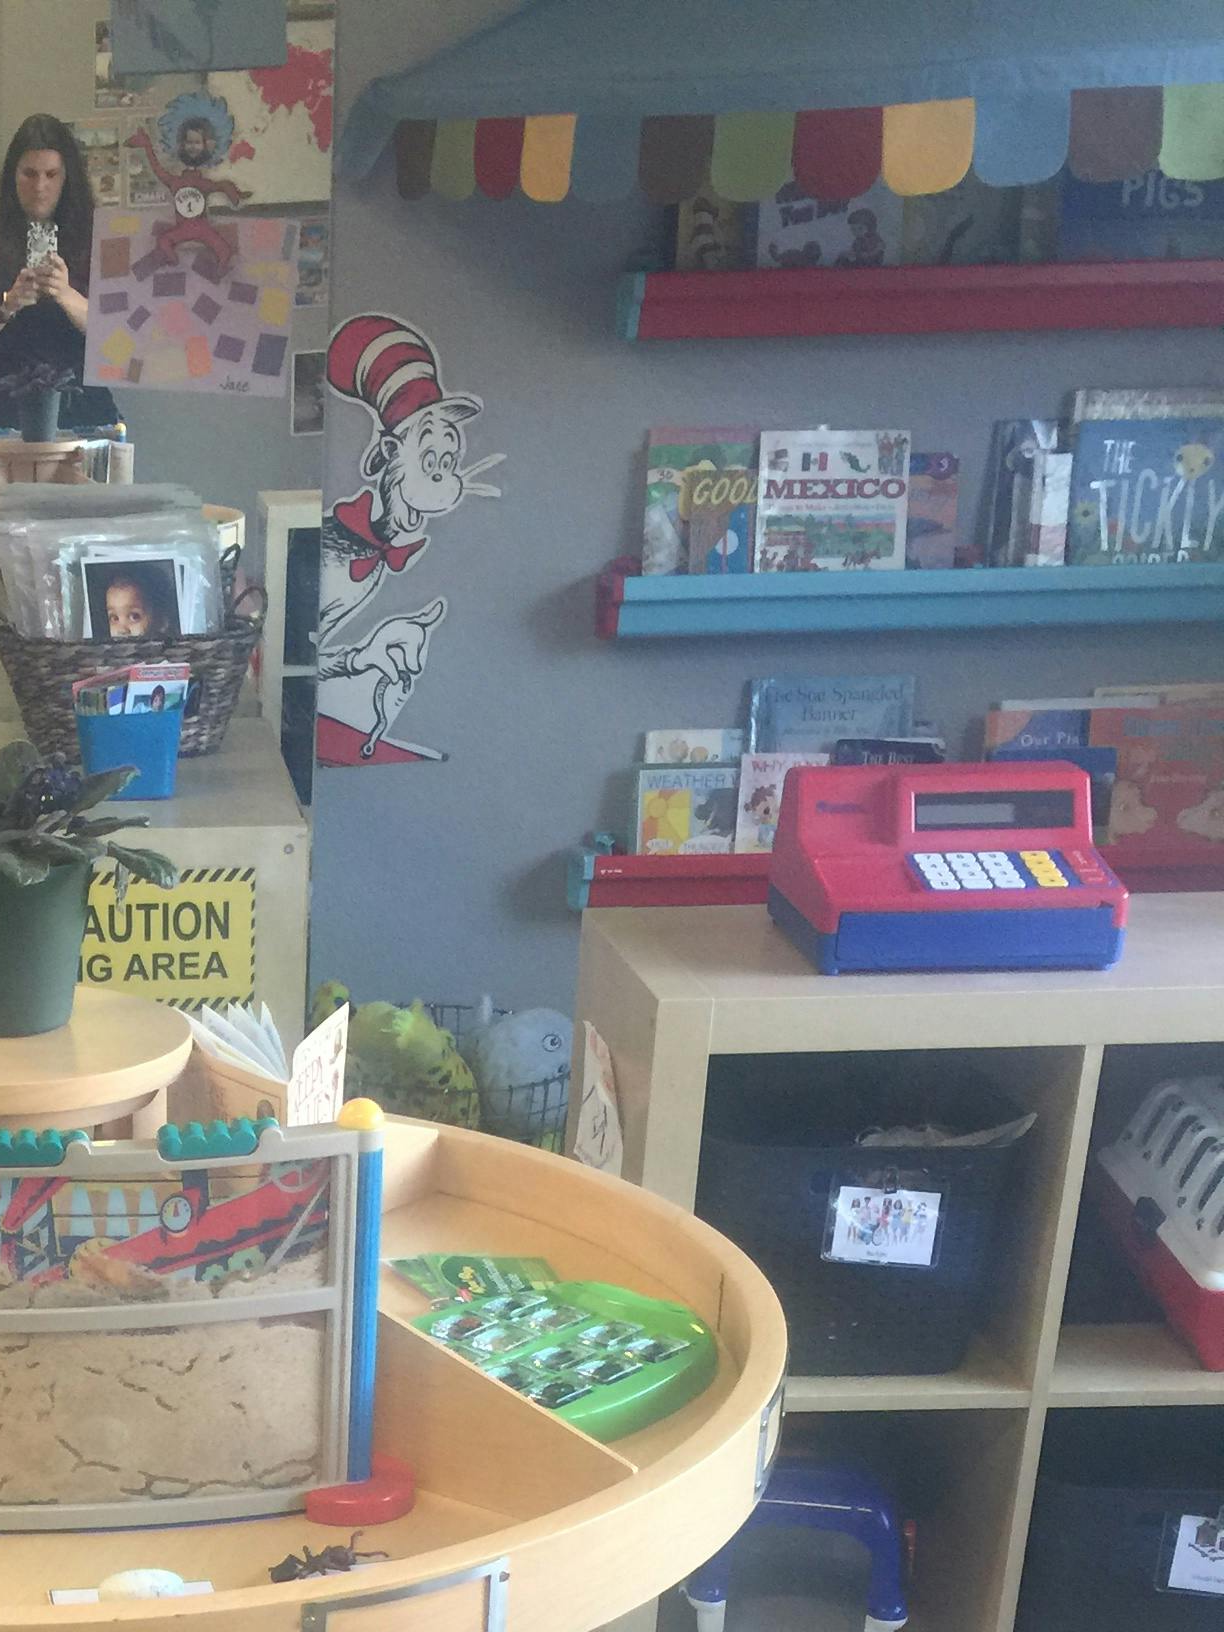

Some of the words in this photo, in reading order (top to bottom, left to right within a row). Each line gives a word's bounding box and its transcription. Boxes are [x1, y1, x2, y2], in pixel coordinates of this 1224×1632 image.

[1103, 439, 1136, 475] THE
[763, 479, 906, 499] MEXICO
[1089, 467, 1224, 552] TICKLY
[1020, 734, 1049, 748] Our
[647, 773, 726, 789] WEATHER
[82, 901, 230, 943] AUTION
[123, 951, 228, 981] AREA
